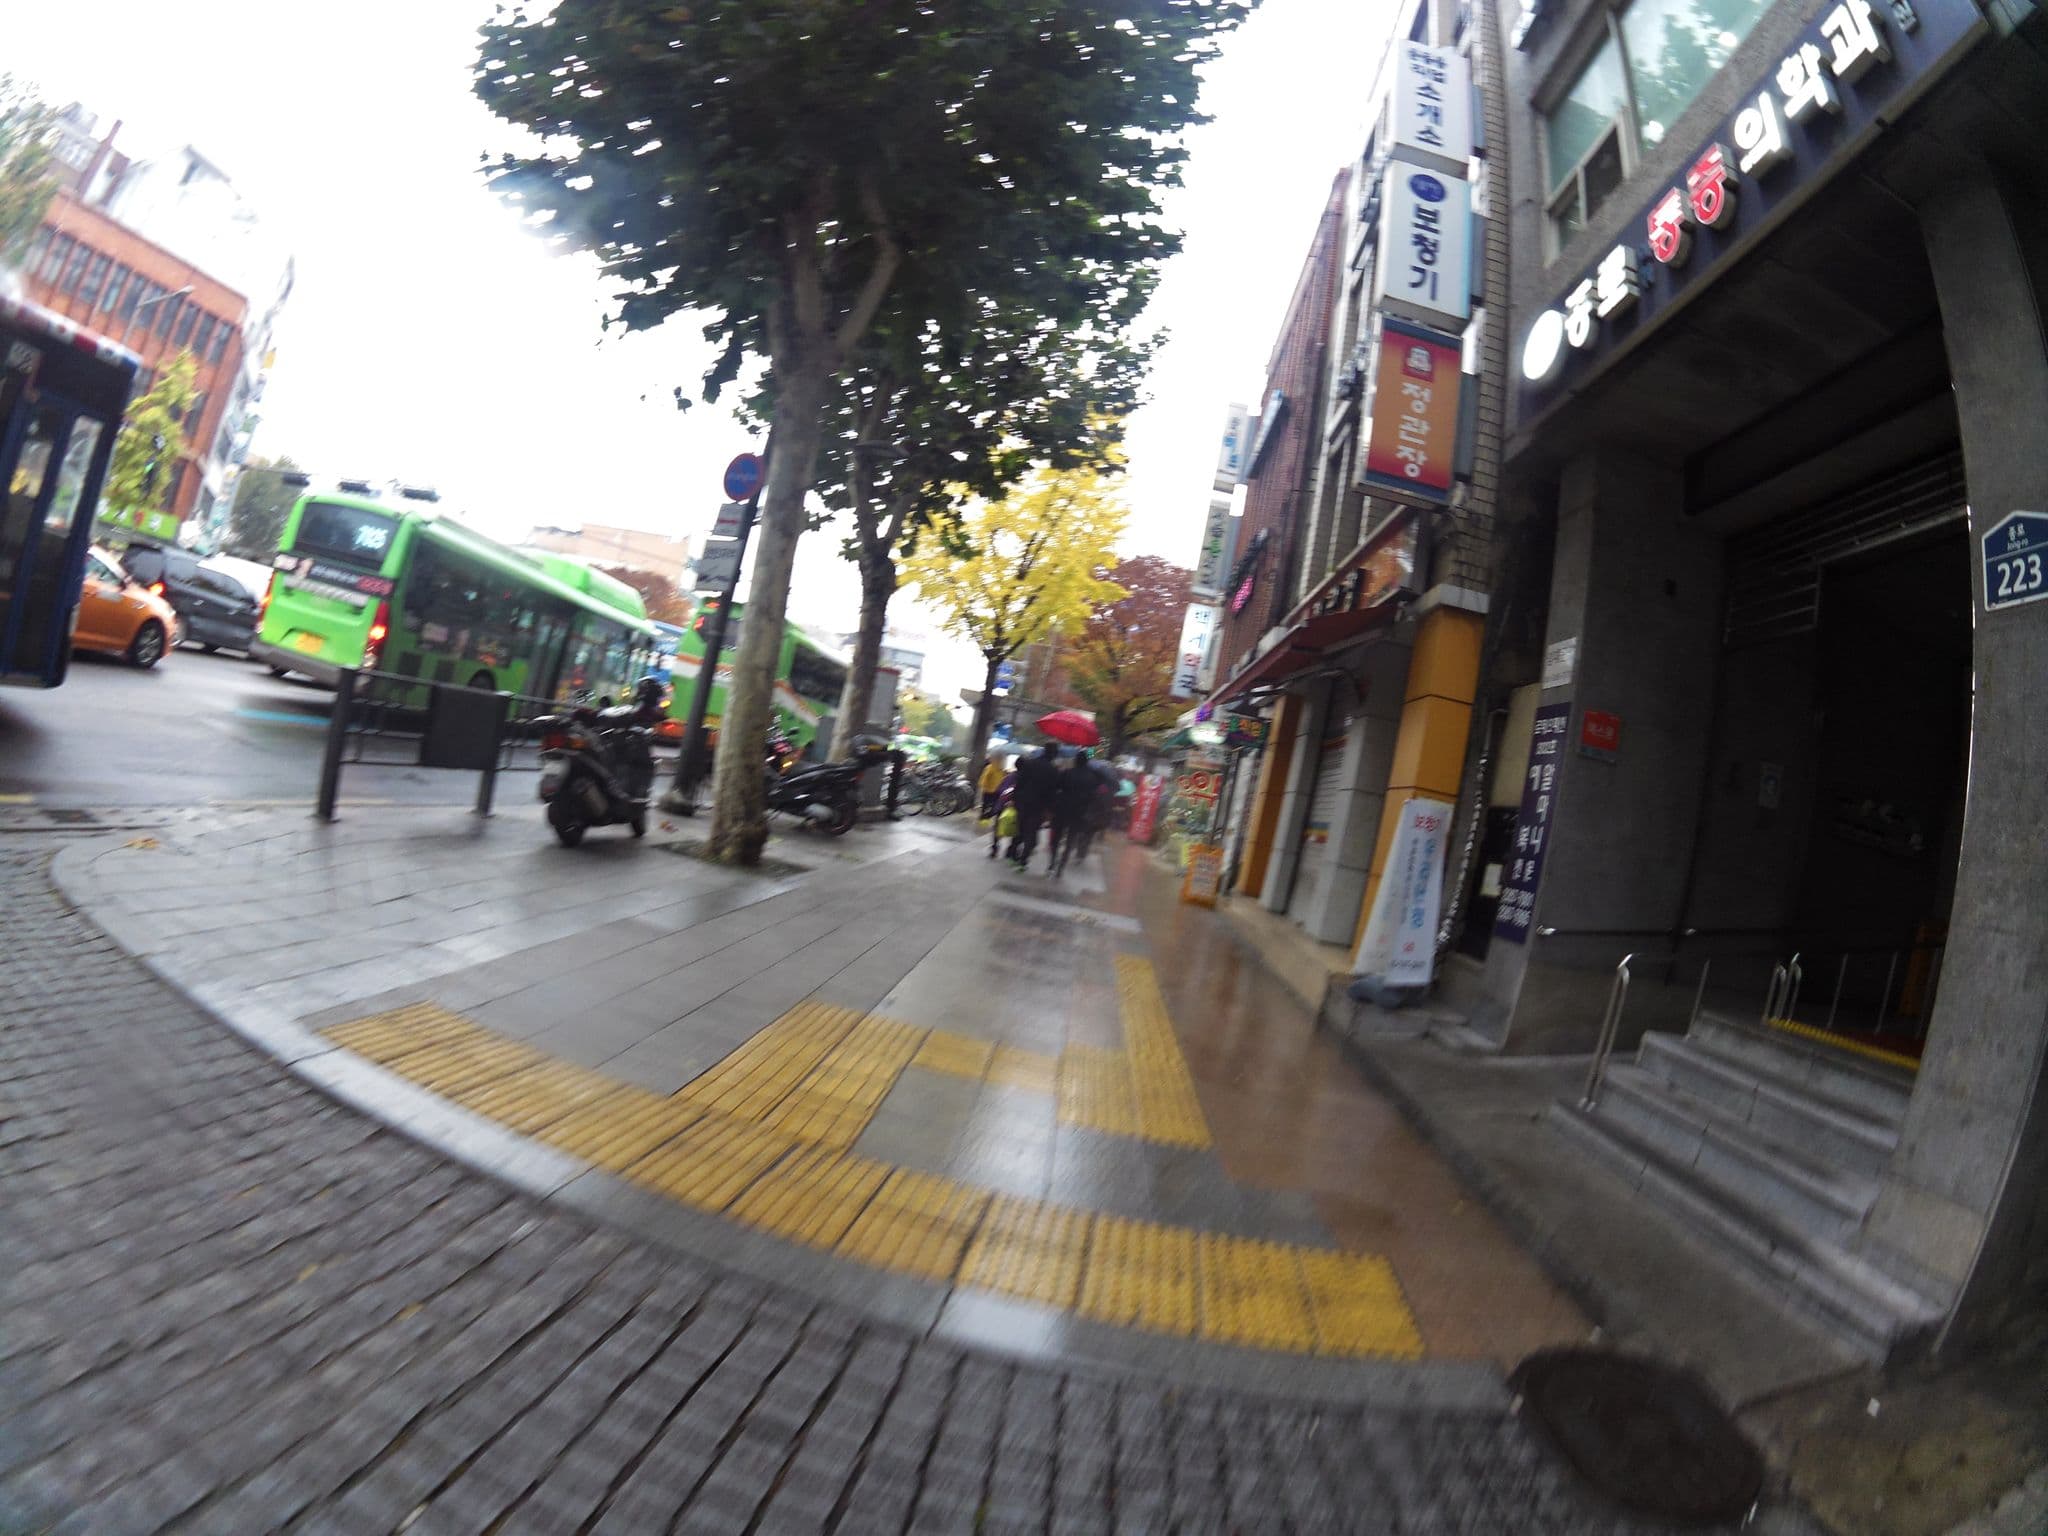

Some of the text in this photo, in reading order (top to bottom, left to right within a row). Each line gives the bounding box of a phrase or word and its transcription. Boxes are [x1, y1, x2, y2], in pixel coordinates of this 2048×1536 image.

[1565, 243, 1640, 349] 종로
[1646, 0, 1890, 265] 통증의학과
[1408, 203, 1441, 302] 보청기
[2008, 523, 2025, 541] 종로
[1997, 553, 2042, 597] 223
